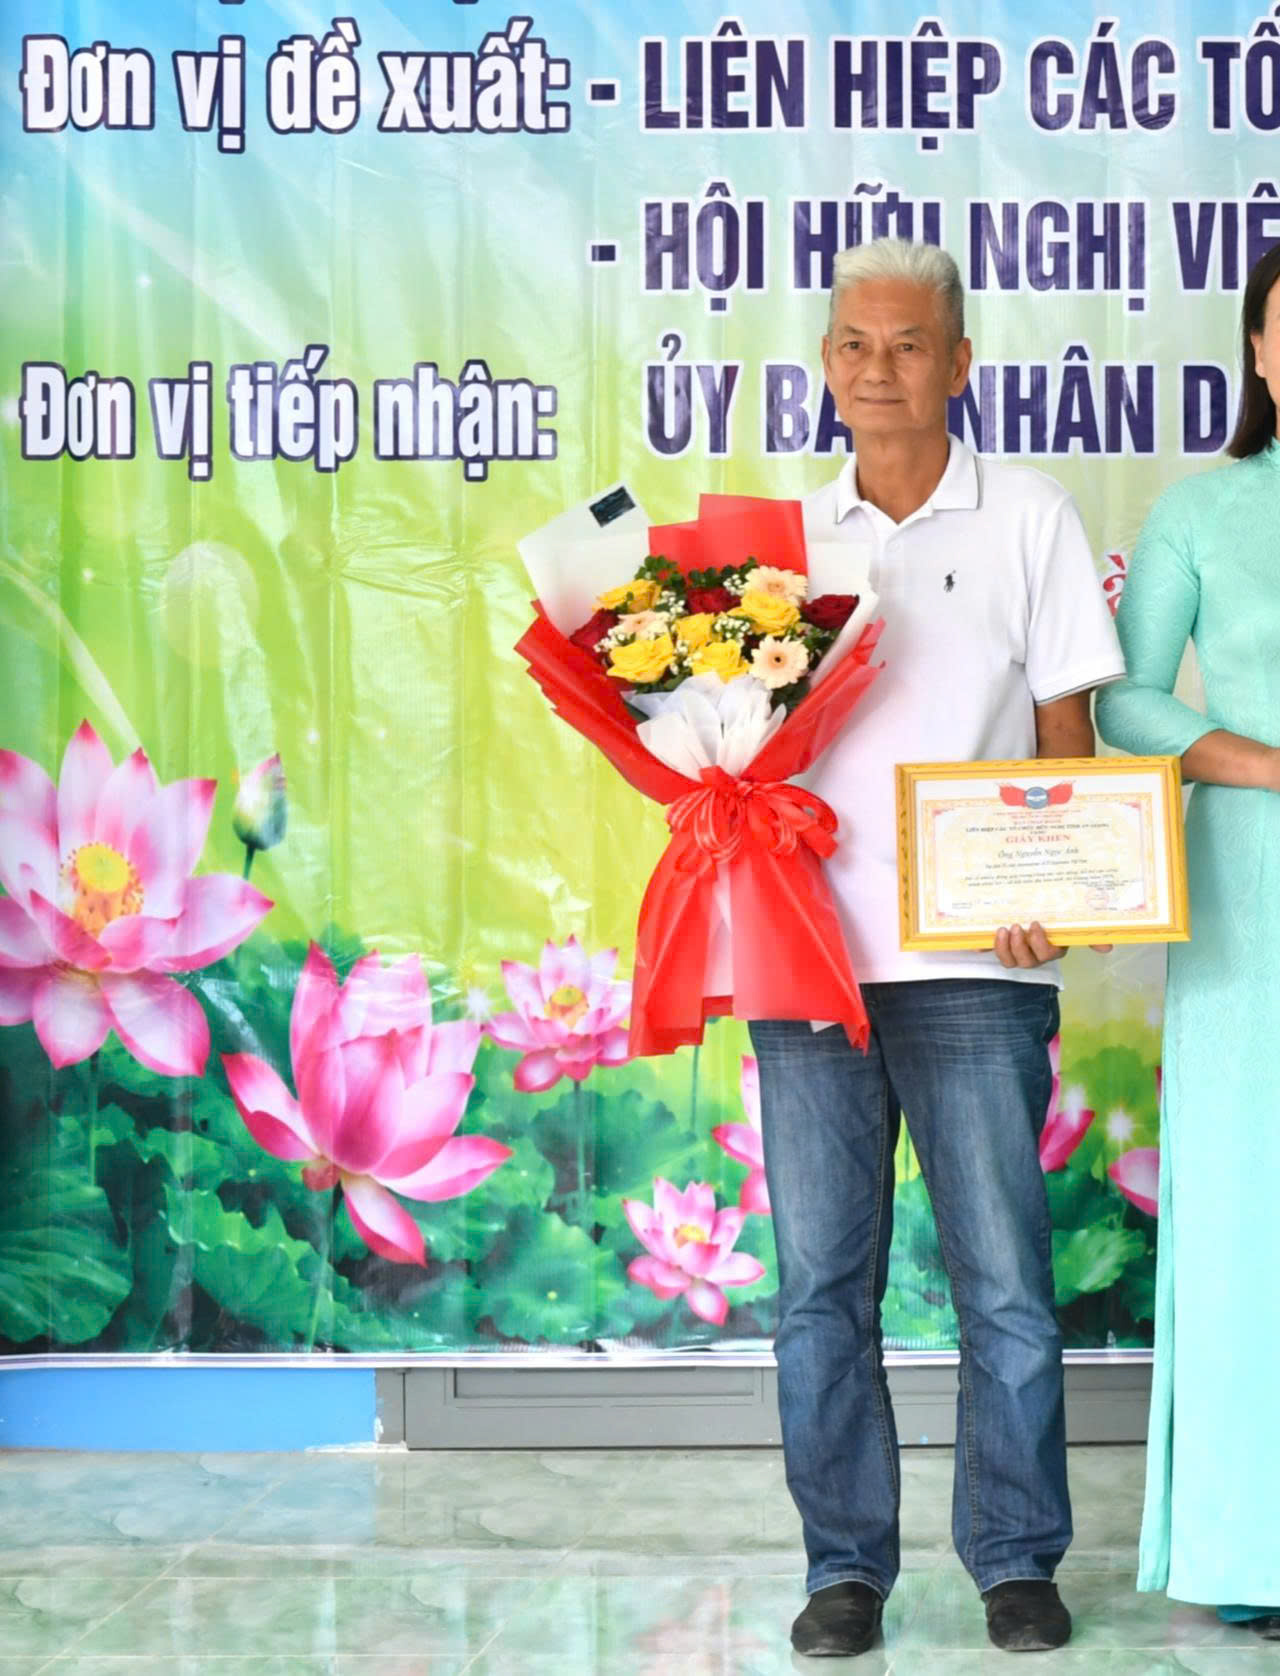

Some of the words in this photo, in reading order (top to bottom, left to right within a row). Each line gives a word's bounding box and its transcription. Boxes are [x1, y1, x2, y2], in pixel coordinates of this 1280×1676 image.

[19, 35, 154, 133] Đơn
[172, 35, 246, 154] vị
[266, 18, 361, 134] đề
[378, 17, 571, 134] xuất:
[644, 21, 804, 129] LIÊN
[834, 21, 995, 150] HIỆP
[1029, 22, 1175, 131] CÁC
[645, 182, 764, 311] HỘI
[970, 202, 1145, 311] NGHỊ
[19, 361, 136, 462] Đơn
[149, 361, 214, 481] vị
[228, 344, 358, 473] tiếp
[373, 359, 559, 482] nhận:
[646, 333, 739, 454] ỦY
[766, 364, 854, 453] BA
